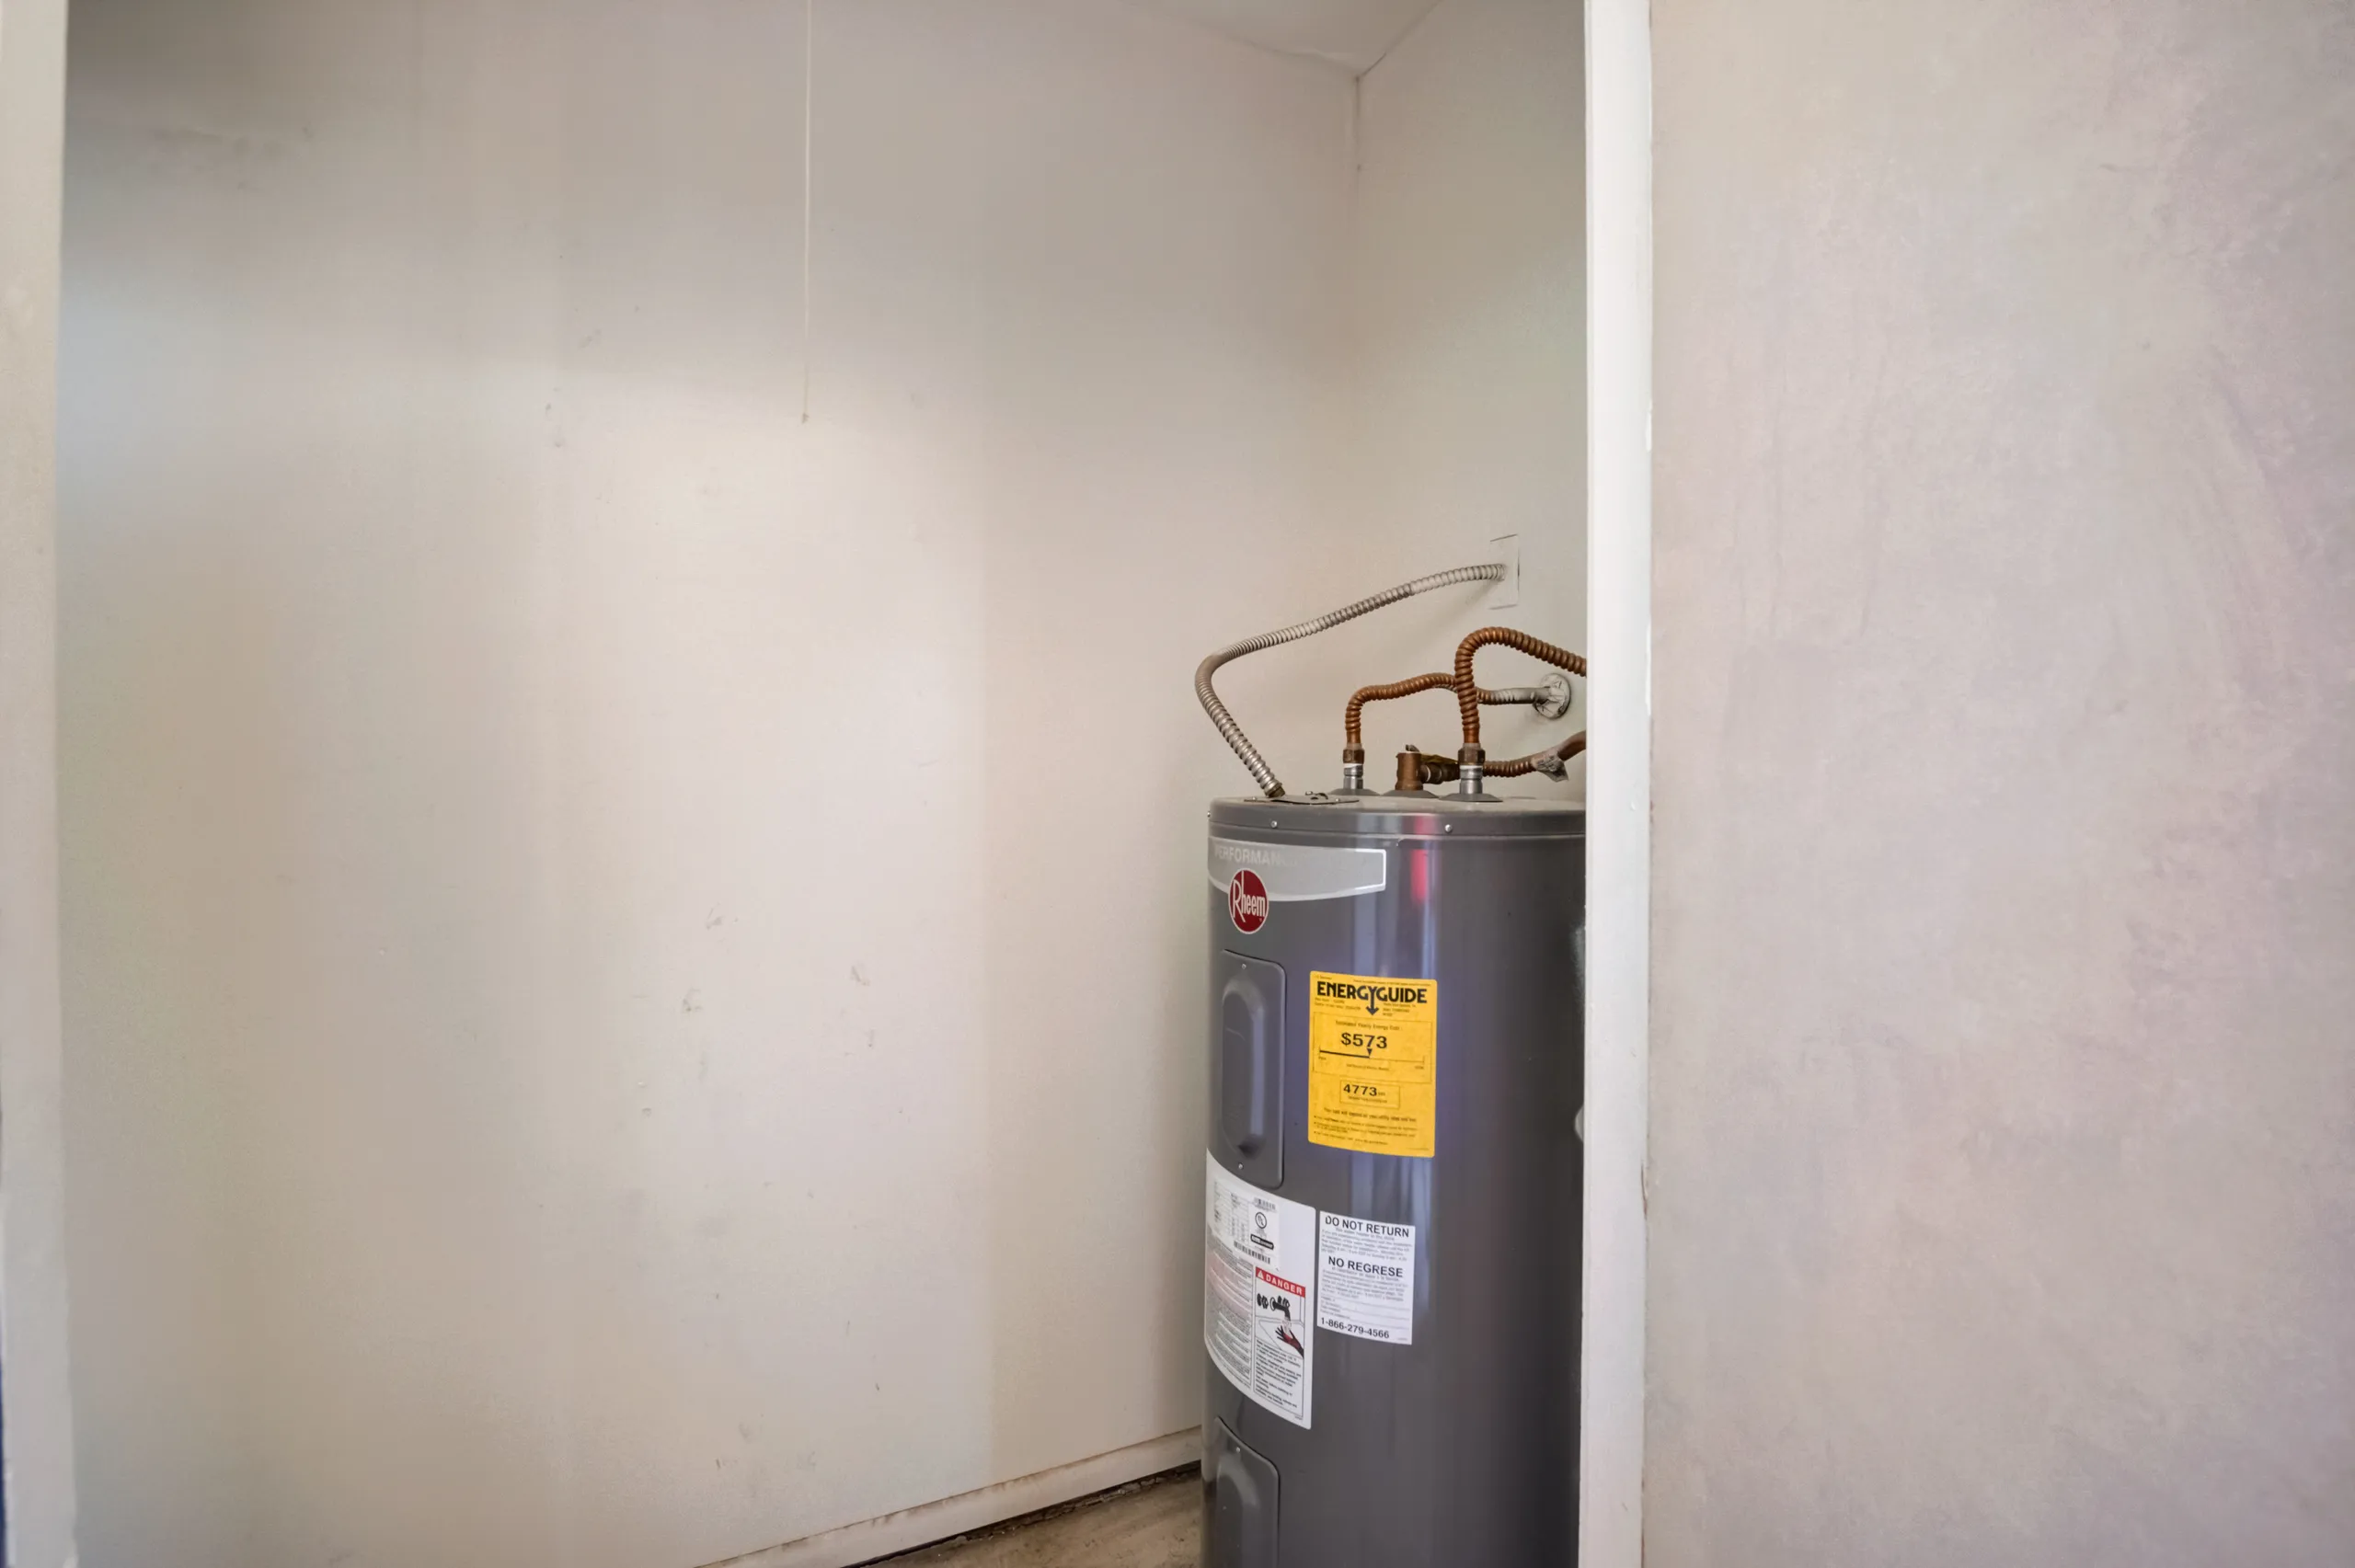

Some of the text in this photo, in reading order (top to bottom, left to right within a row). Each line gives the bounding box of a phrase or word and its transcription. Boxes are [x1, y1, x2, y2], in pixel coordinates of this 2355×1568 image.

[1233, 871, 1266, 922] Rheem
[1316, 980, 1428, 1006] ENERGYGUIDE
[1340, 1032, 1387, 1049] $573
[1343, 1083, 1377, 1096] 4773
[1325, 1215, 1409, 1238] DO NOT RETURN
[1328, 1255, 1403, 1277] NO REGRESE
[1265, 1271, 1303, 1296] DANGER
[1321, 1317, 1390, 1339] 1-866-279-4566
